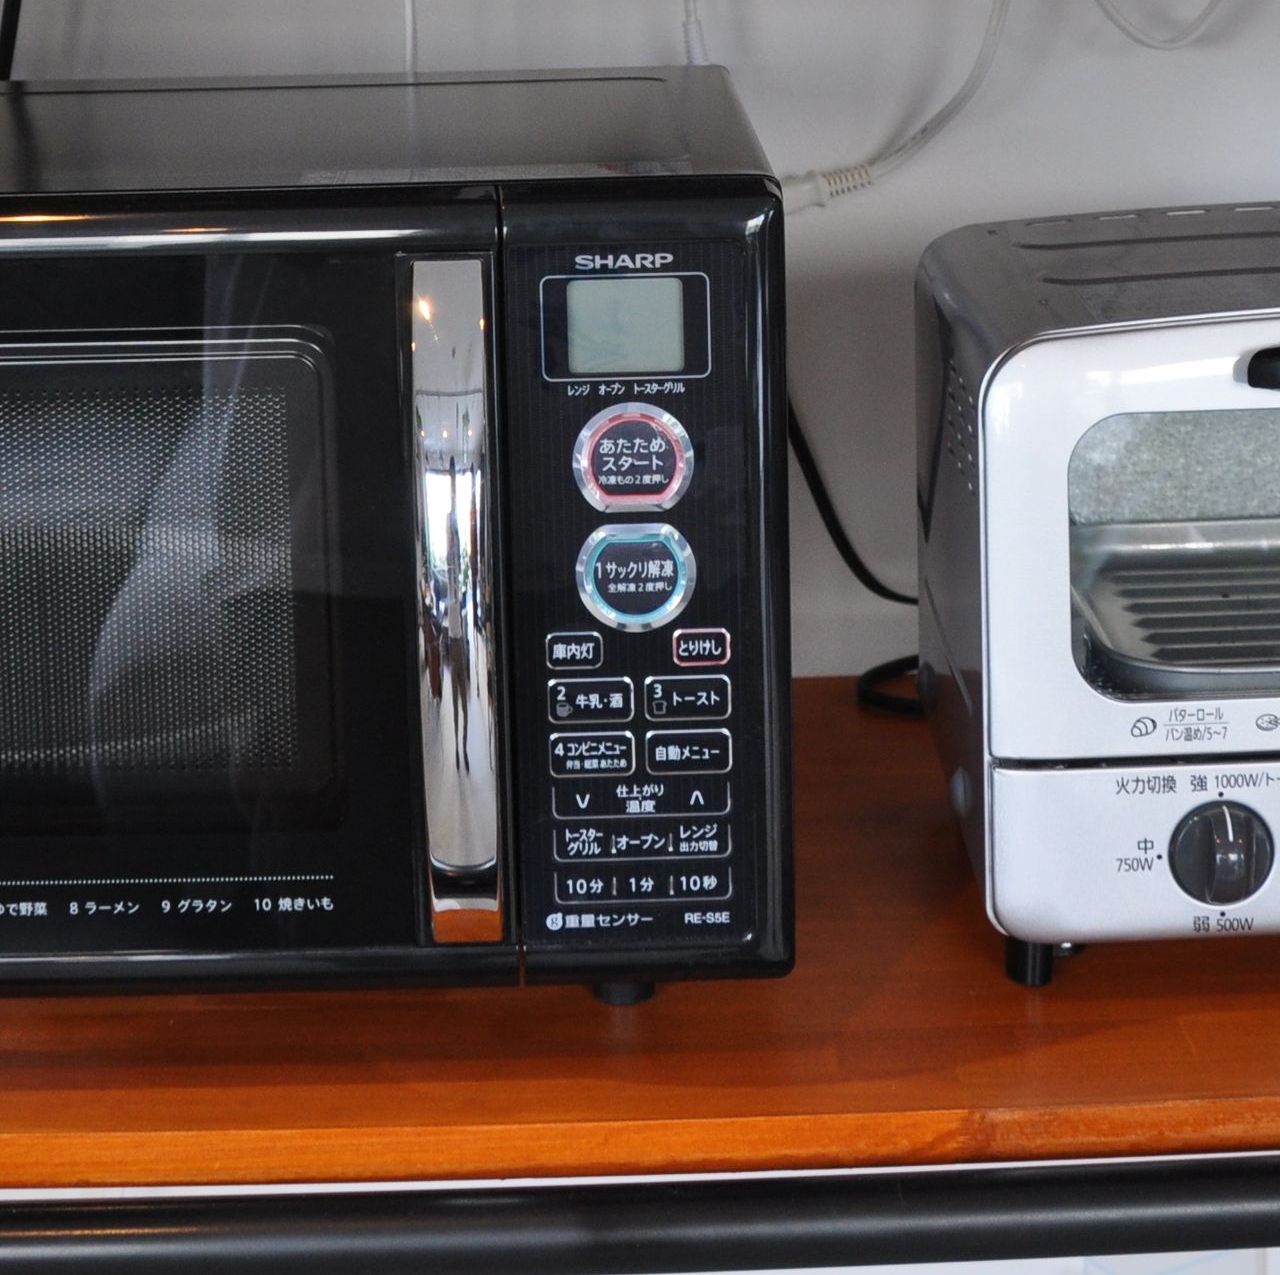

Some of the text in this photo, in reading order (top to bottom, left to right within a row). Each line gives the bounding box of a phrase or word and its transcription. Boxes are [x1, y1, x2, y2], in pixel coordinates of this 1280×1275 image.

[575, 253, 673, 270] SHARP
[568, 384, 590, 396] レンジ
[599, 436, 666, 454] あたため
[602, 454, 664, 471] スタート
[605, 559, 674, 579] サックリ解凍
[553, 643, 595, 660] 庫内灯
[679, 639, 721, 656] とりけし
[556, 686, 623, 709] 2 牛乳・酒
[653, 684, 720, 706] 3 トースト
[554, 742, 627, 756] 4 コンビニメニュー
[655, 745, 720, 761] 自動メニュー
[616, 784, 664, 797] 仕上がり
[1116, 775, 1176, 795] 火力切換
[1190, 775, 1208, 792] 強
[626, 800, 656, 813] 温度
[565, 828, 603, 842] トースター
[679, 823, 718, 839] レンジ
[567, 841, 601, 856] グリル
[616, 833, 666, 850] オーブン
[679, 839, 718, 852] 出力切替
[1138, 838, 1153, 854] 中
[1116, 858, 1153, 872] 750W
[566, 879, 604, 894] 10分
[629, 877, 654, 892] 1分
[680, 875, 718, 890] 10秒
[69, 901, 140, 915] 8 ラーメン
[161, 899, 232, 914] 9 グラタン
[254, 897, 334, 912] 10 焼きいも
[1193, 917, 1254, 932] 弱 500W
